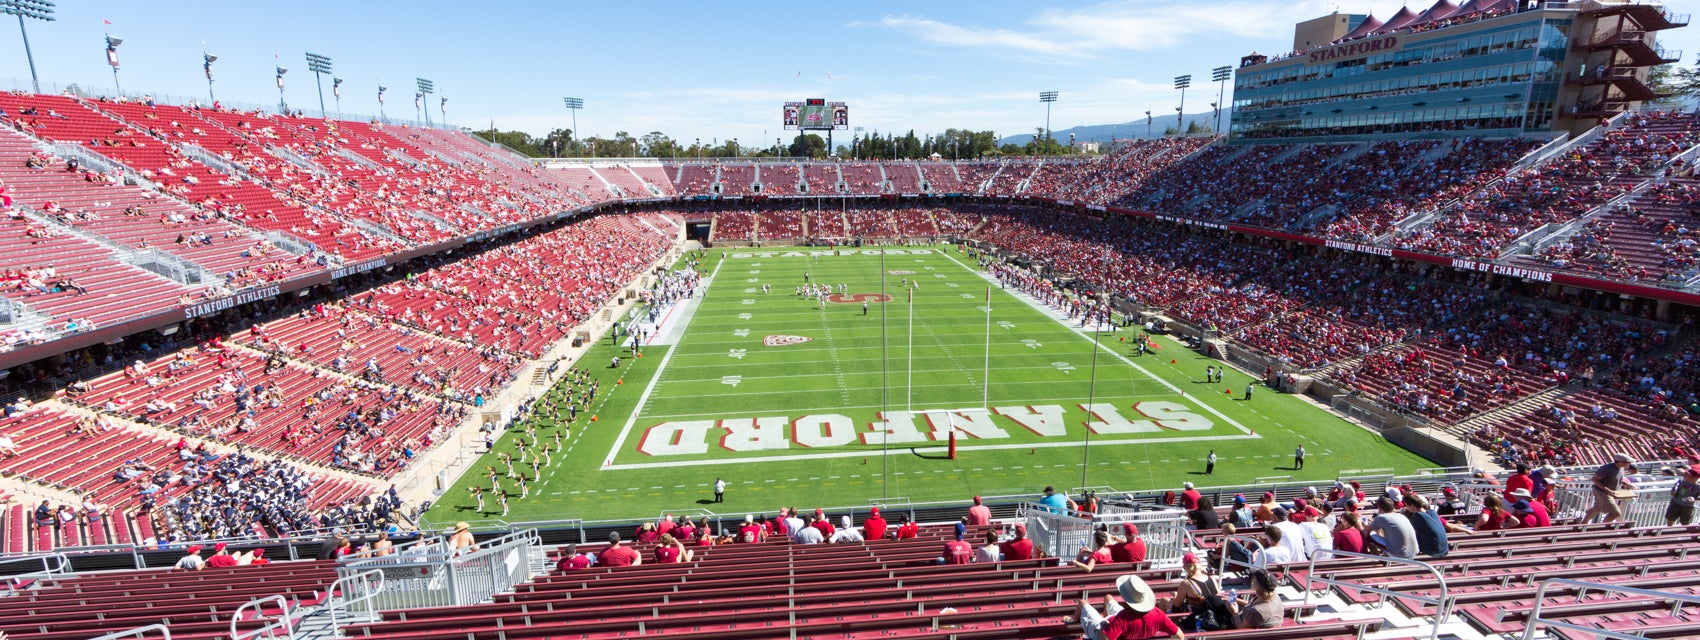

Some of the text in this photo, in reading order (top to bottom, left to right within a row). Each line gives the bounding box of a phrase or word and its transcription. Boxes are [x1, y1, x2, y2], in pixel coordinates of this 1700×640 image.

[1310, 36, 1396, 62] STANFORD
[732, 250, 933, 258] STANFORD
[1325, 240, 1393, 257] STANFORD ATHLETICS
[331, 258, 387, 280] HOME OF CHAMPIONS
[1452, 259, 1553, 282] HOME OF CHAMPIONS
[184, 285, 280, 319] STANFORD ATHLETICS
[638, 401, 1214, 456] STANFORD
